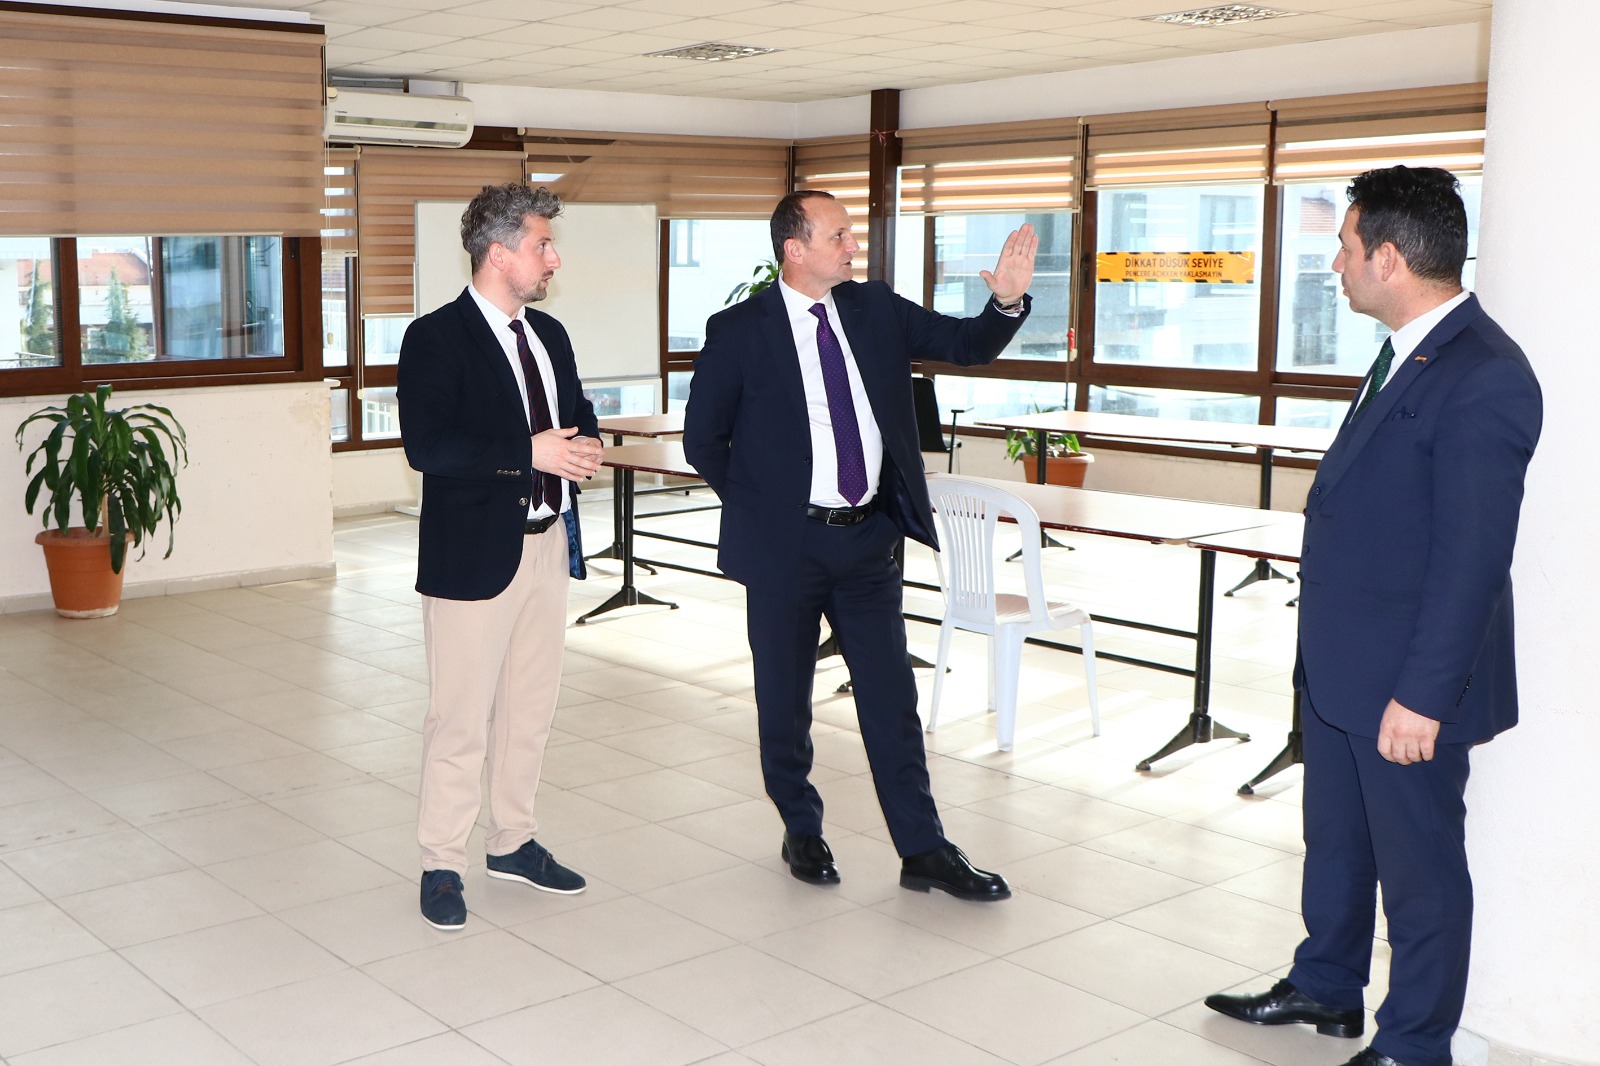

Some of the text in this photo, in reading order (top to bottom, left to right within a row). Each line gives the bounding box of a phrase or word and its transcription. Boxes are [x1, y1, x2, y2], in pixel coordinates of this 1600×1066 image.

[1125, 256, 1223, 269] DİKKAT DÜŞÜK SEVİYE
[1180, 270, 1223, 278] YAKLAŞMAYIN
